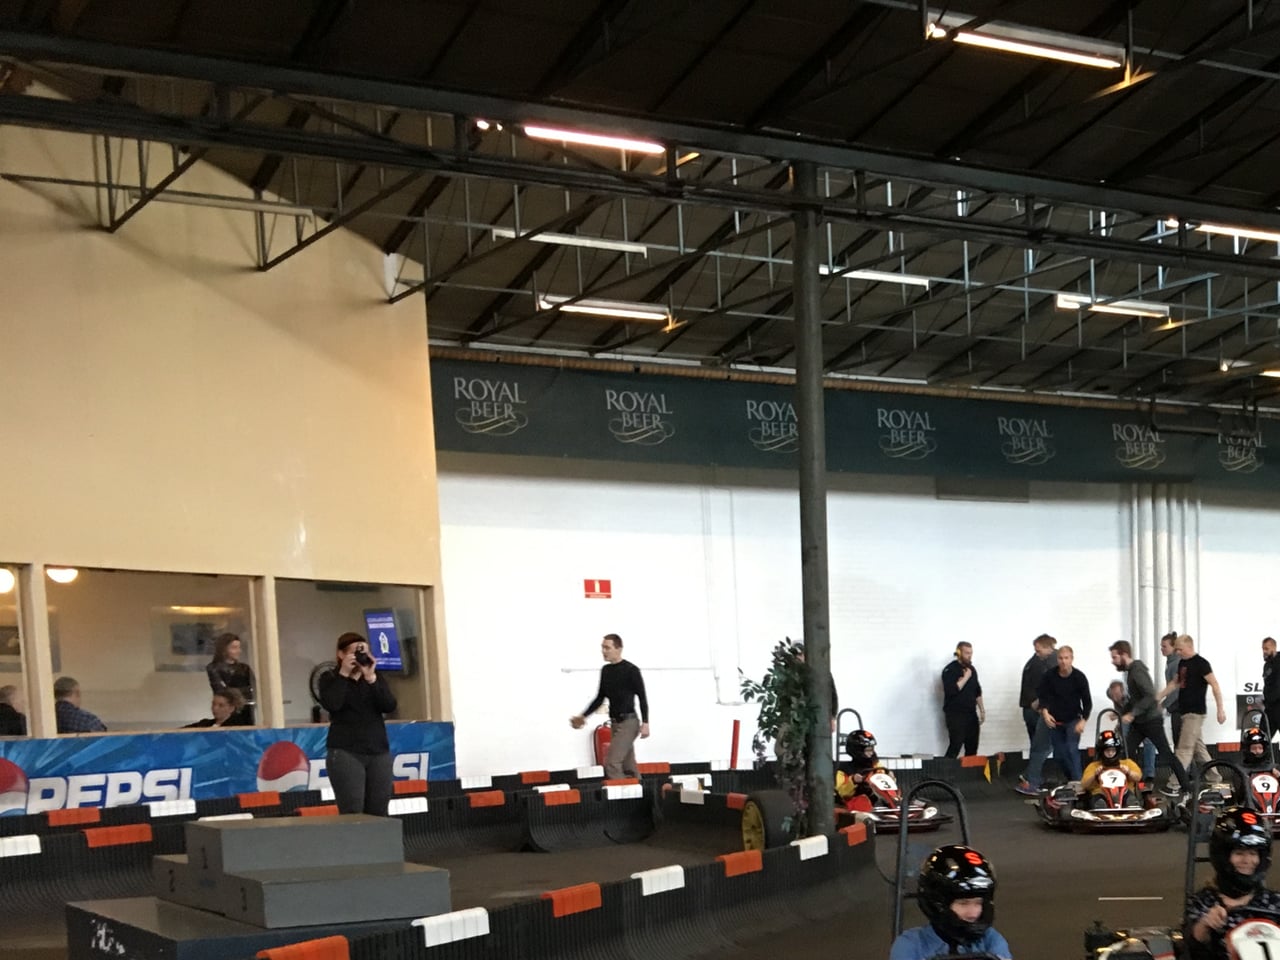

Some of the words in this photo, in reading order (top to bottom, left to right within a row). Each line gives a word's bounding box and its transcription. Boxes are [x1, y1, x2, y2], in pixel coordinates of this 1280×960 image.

[454, 377, 526, 404] ROYAL
[471, 401, 516, 420] BEER
[605, 389, 673, 414] ROYAL
[747, 400, 798, 422] ROYA
[877, 408, 936, 431] ROYAL
[622, 412, 664, 430] BEER
[761, 421, 799, 437] BEER
[997, 417, 1053, 438] ROYAL
[890, 429, 927, 446] BEER
[1011, 435, 1044, 450] BEER
[1112, 424, 1165, 443] ROYAL
[1125, 441, 1157, 457] BEER
[25, 768, 194, 814] PEPSI
[881, 780, 891, 789] 3
[1262, 782, 1270, 791] 9
[1241, 813, 1257, 825] S
[964, 852, 983, 865] S
